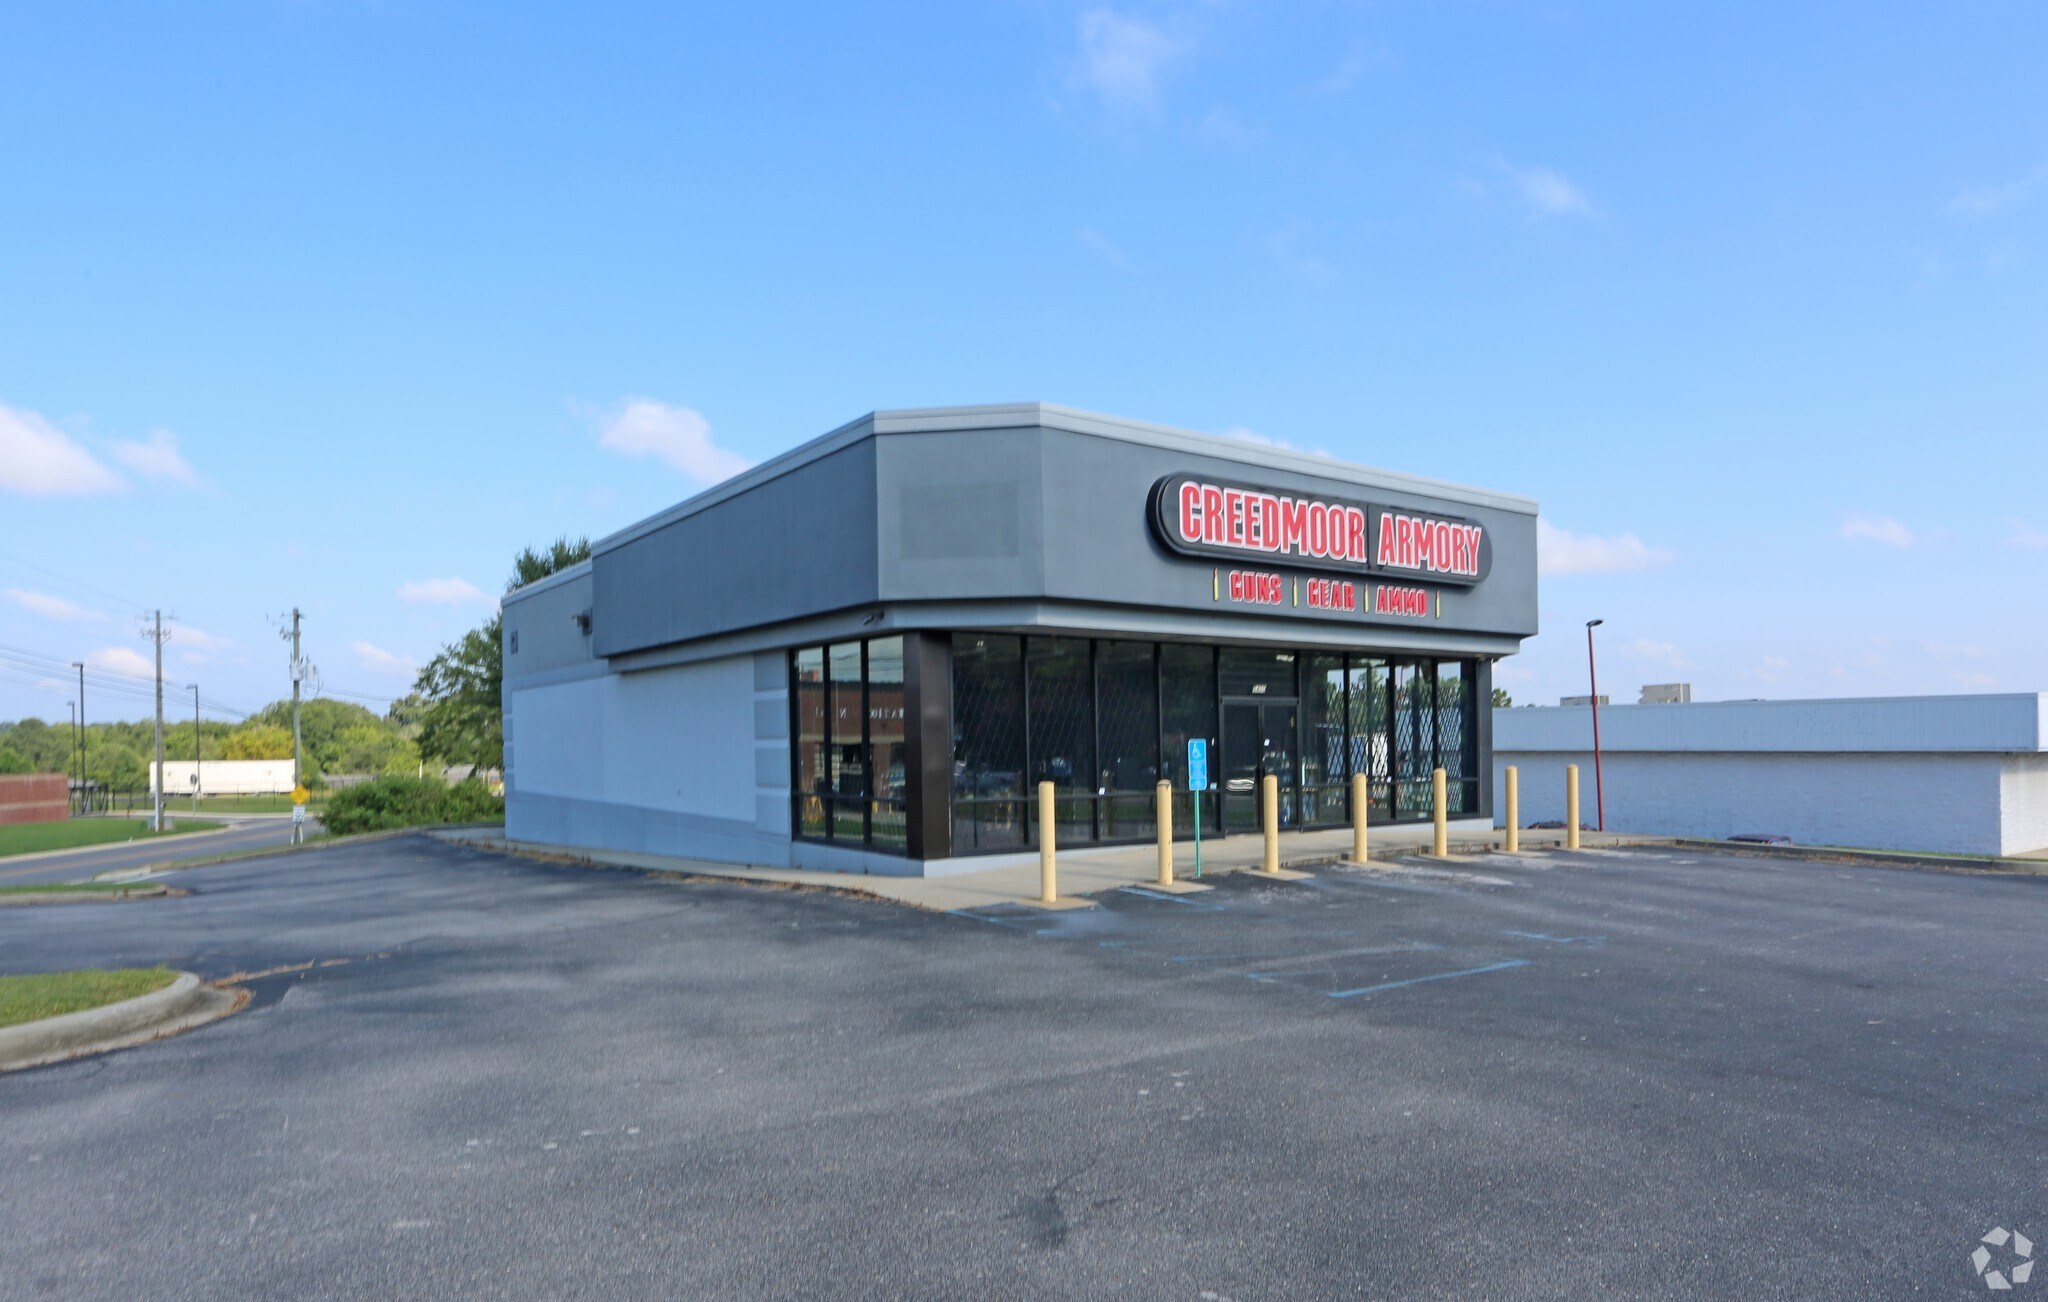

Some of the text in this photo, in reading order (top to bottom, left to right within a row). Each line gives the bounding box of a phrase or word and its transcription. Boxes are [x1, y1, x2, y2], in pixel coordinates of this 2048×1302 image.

[1179, 480, 1482, 575] CREEDMOOR ARMORY
[1229, 569, 1428, 617] GUNS GEAR AMMO
